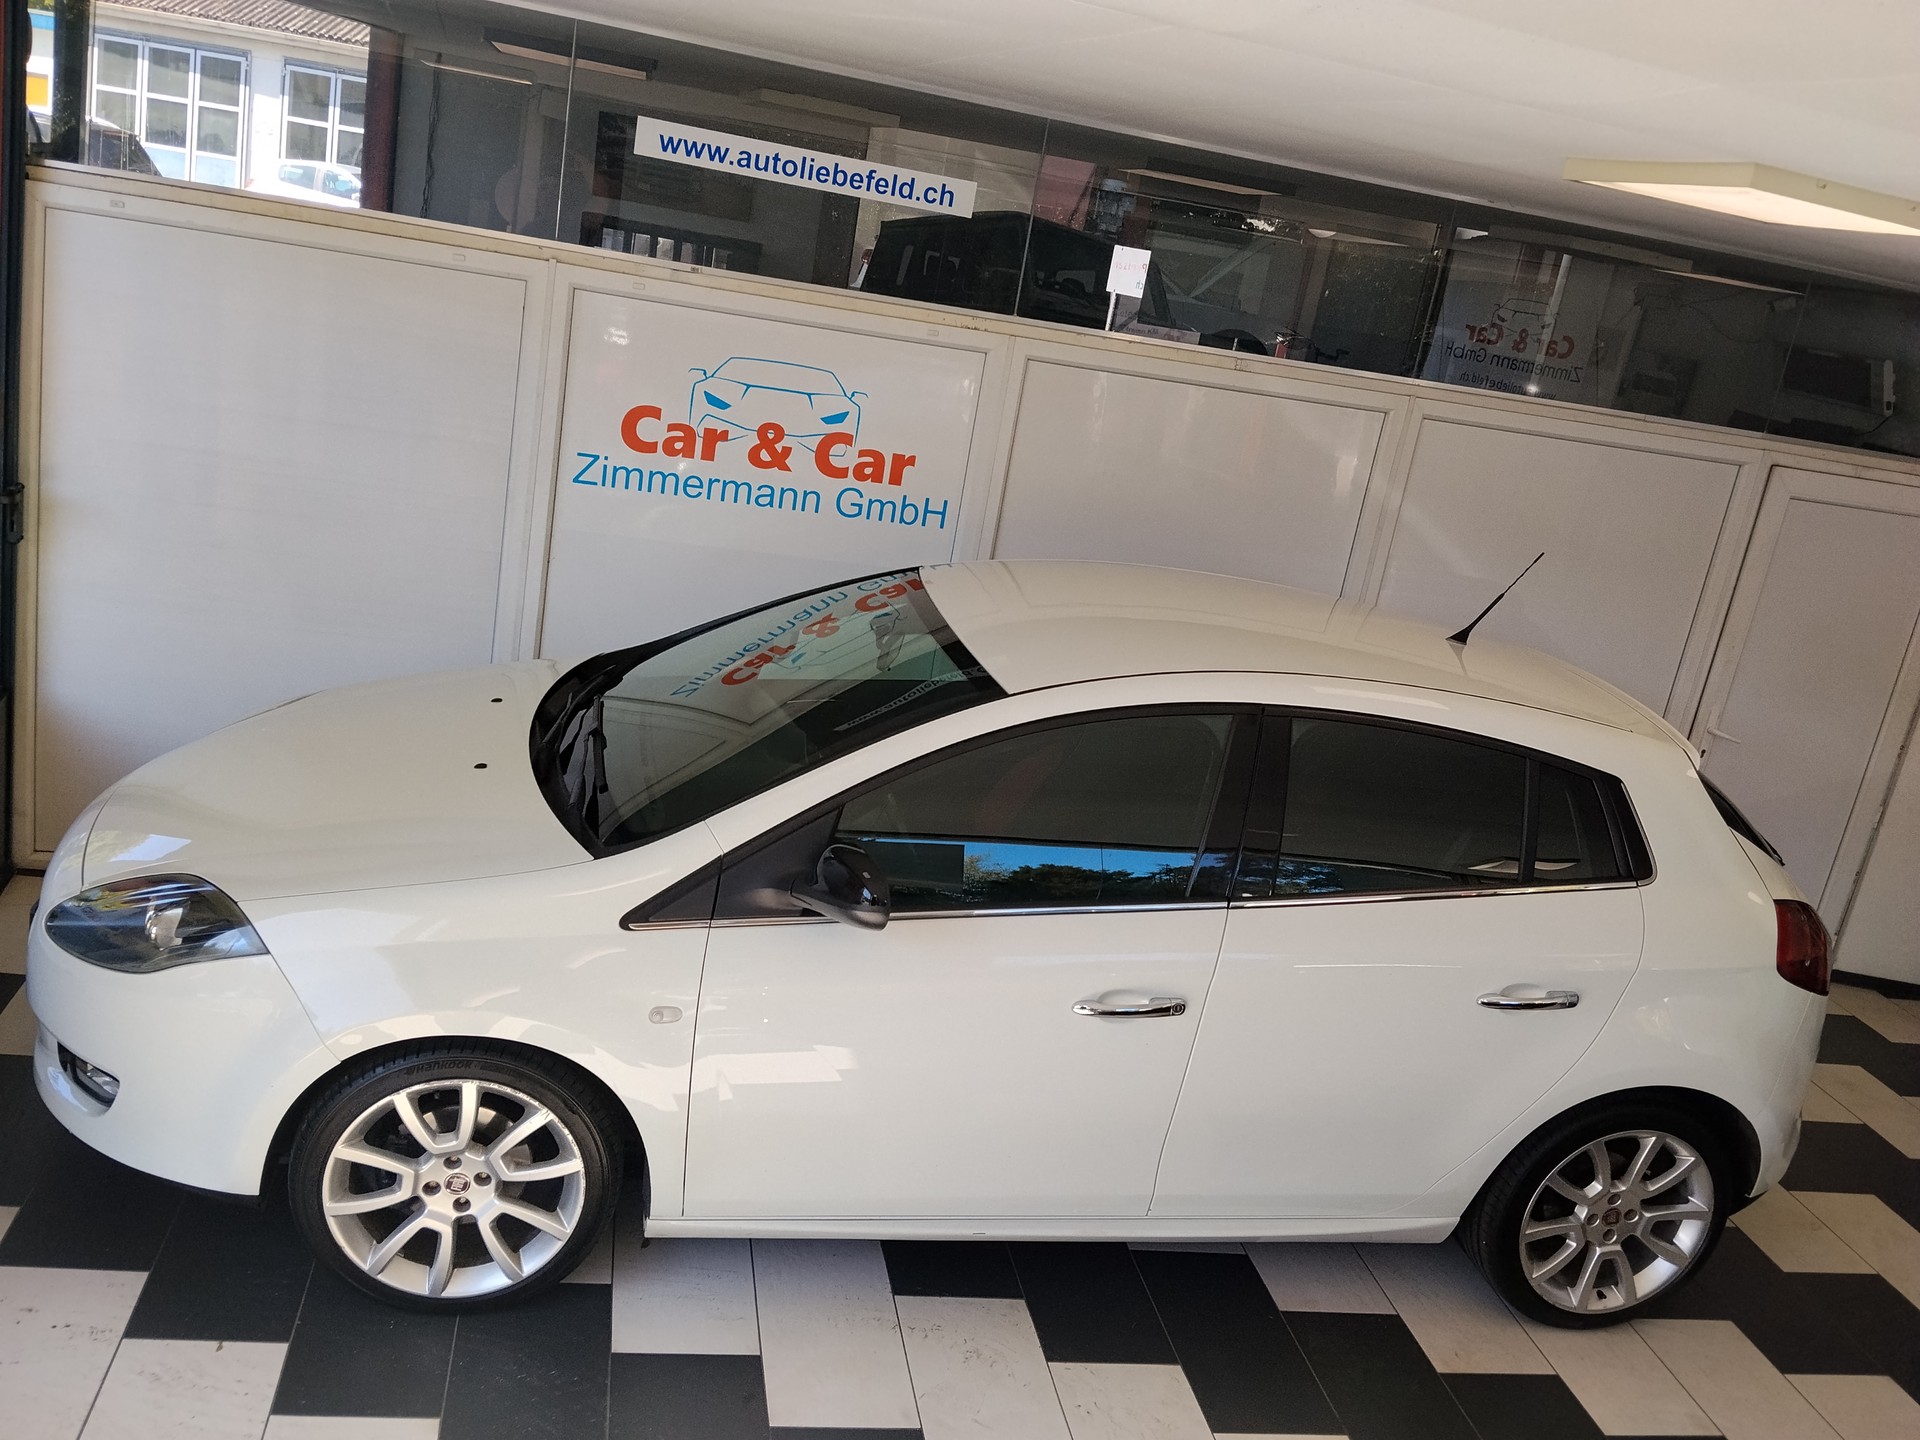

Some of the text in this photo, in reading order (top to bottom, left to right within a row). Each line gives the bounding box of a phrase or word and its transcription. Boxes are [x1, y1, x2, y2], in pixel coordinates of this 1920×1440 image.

[658, 133, 956, 209] www.autoliebefeld.ch
[620, 405, 917, 487] Car & Car
[572, 452, 949, 529] Zimmermann GmbH
[415, 1060, 473, 1073] Hankook
